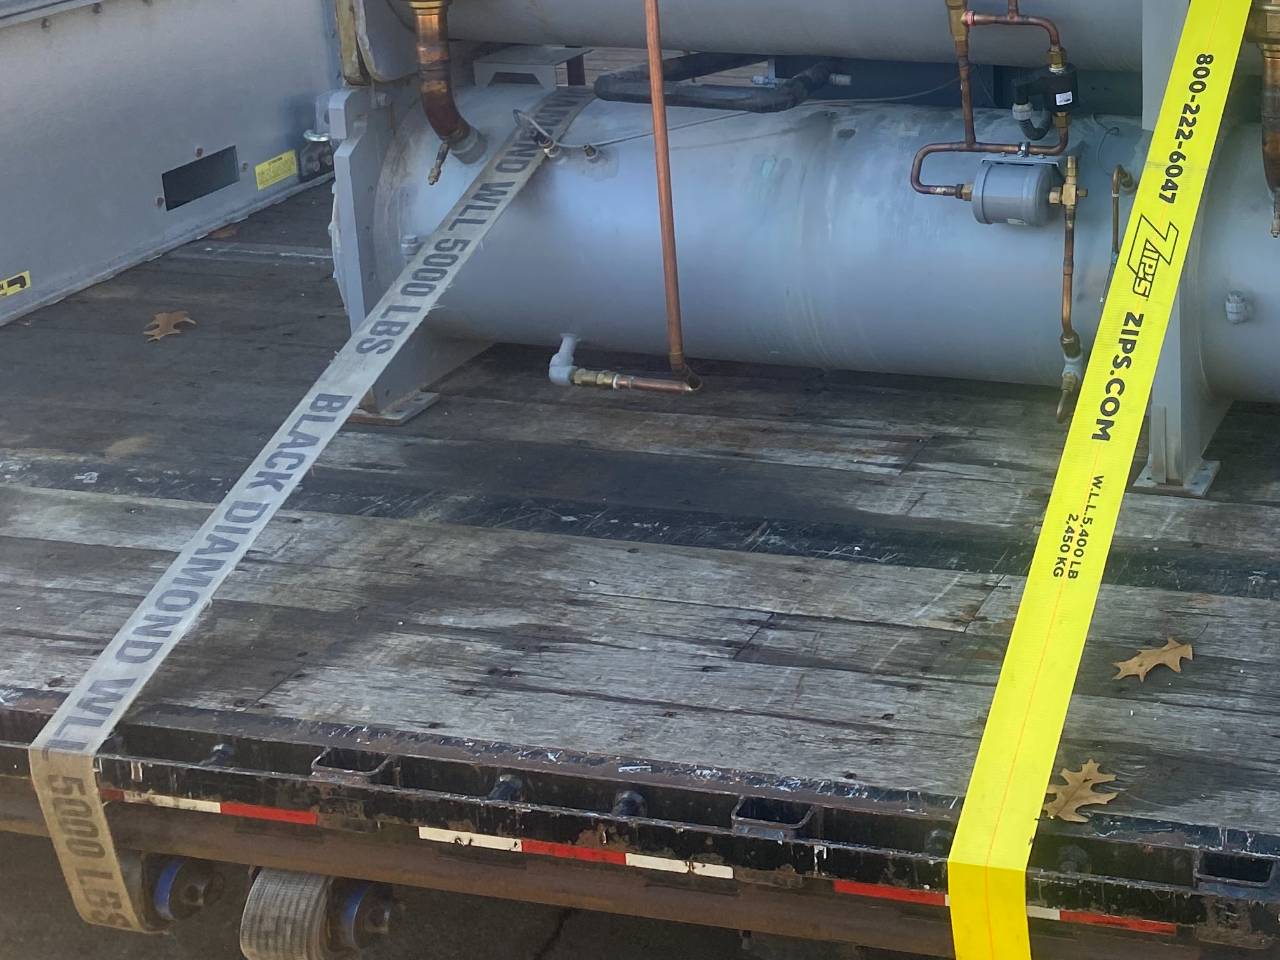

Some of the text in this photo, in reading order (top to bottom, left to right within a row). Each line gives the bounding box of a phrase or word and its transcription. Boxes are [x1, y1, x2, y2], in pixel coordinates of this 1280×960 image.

[1158, 53, 1214, 204] 800-222-6047
[447, 181, 516, 232] WLL
[400, 238, 472, 297] 5000
[355, 304, 422, 355] LBS
[1091, 311, 1145, 442] ZIPS.COM
[246, 392, 353, 493] BLACK
[115, 500, 272, 664] DIAMOND
[1053, 513, 1079, 578] 2,450 KG
[1067, 560, 1082, 579] LB
[43, 677, 138, 761] WLL
[48, 773, 106, 859] 5000
[74, 868, 133, 928] LBS
